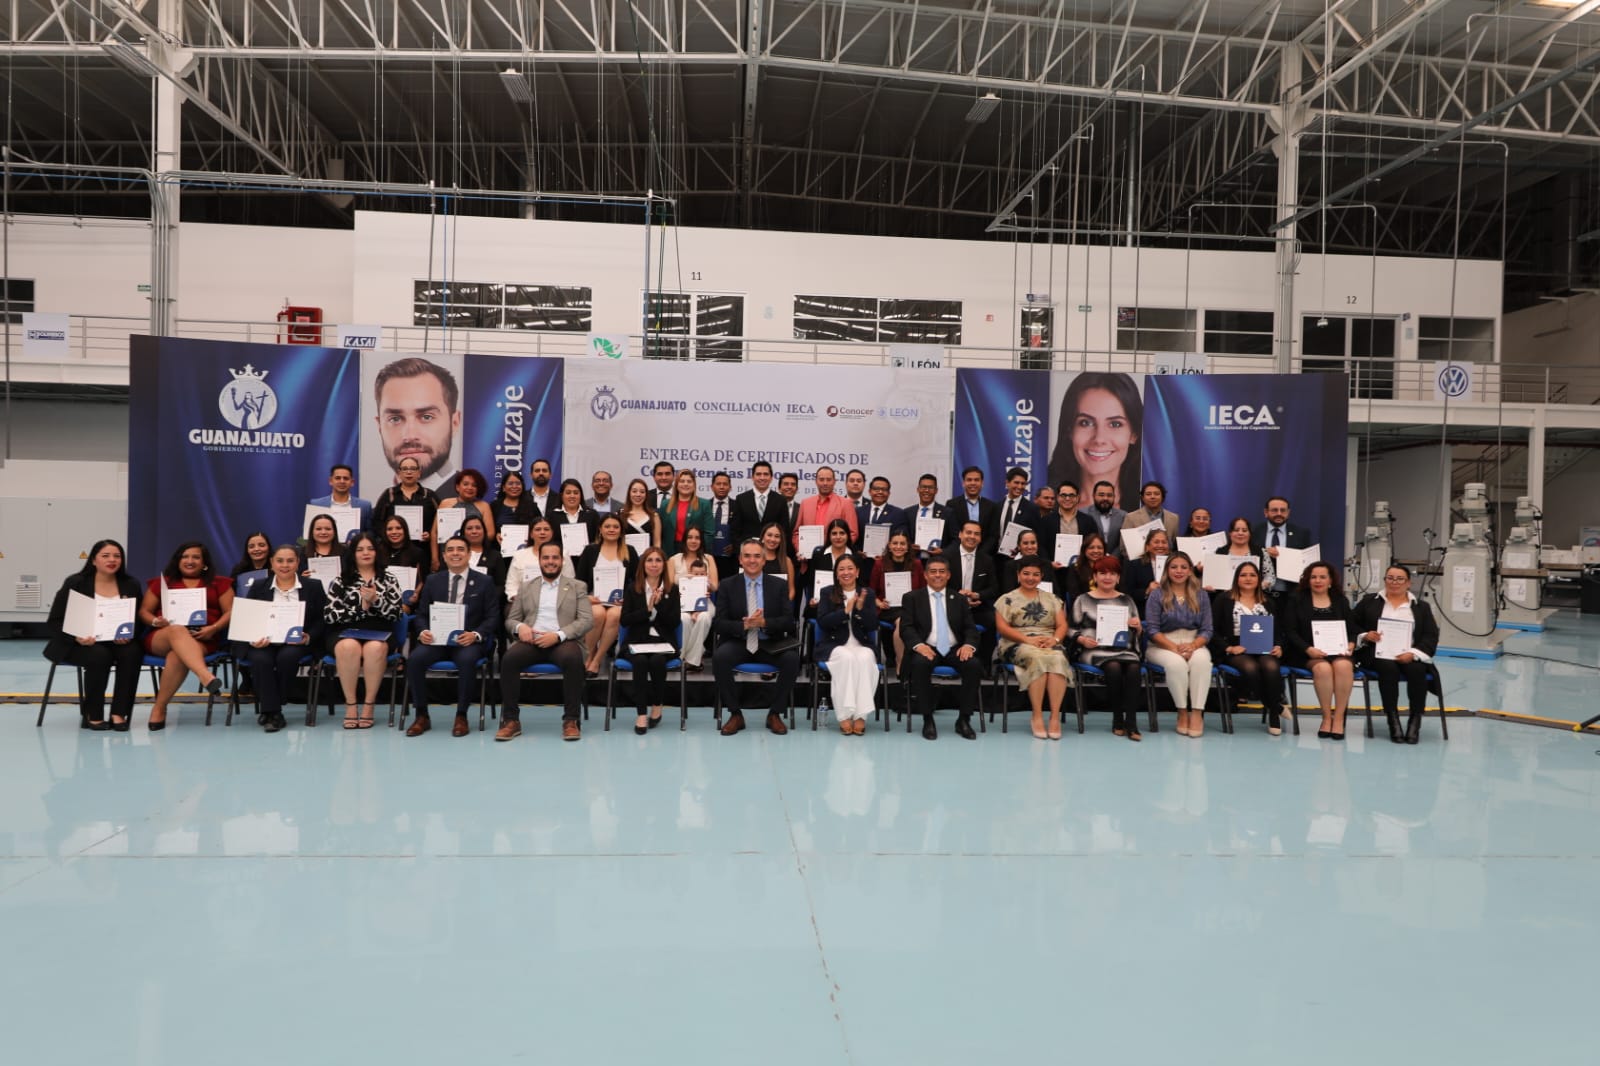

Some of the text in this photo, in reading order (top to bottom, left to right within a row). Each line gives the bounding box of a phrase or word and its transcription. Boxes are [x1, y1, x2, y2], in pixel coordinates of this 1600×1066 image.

[691, 271, 702, 281] 11
[1346, 295, 1357, 304] 12
[345, 337, 376, 348] KASAI
[620, 399, 687, 411] GUANAJUATO
[694, 401, 781, 413] CONCILIACIÓN
[787, 403, 815, 414] IECA
[839, 406, 874, 416] Conocer
[1209, 405, 1275, 425] IECA
[495, 385, 532, 474] dizaje
[188, 428, 305, 448] GUANAJUATO
[203, 445, 242, 453] GOBIERNO
[640, 448, 869, 465] ENTREGA DE CERTIFICADOS DE
